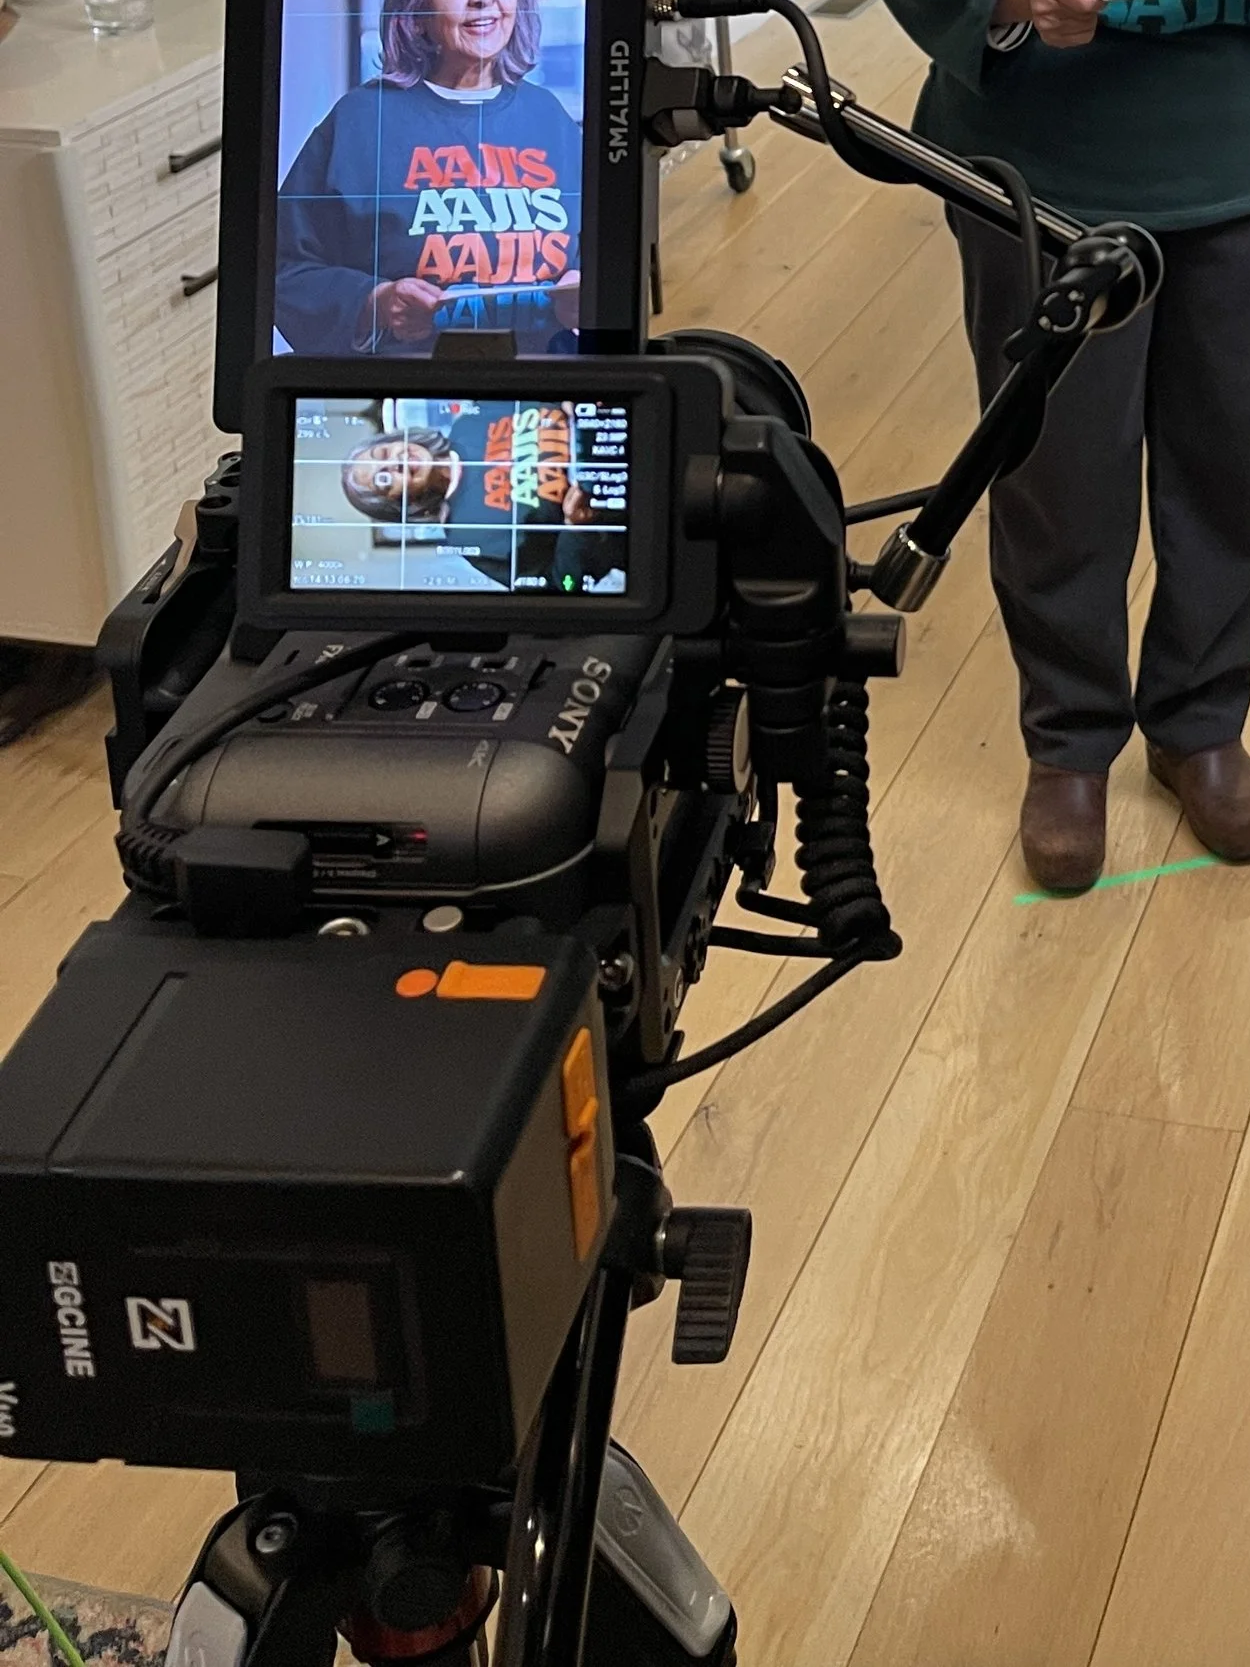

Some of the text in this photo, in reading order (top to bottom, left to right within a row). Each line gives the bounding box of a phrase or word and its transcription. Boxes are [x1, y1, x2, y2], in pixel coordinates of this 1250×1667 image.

[608, 40, 630, 164] SMALLHD
[403, 143, 557, 190] AAJI'S
[408, 187, 569, 236] AAJI'S
[416, 230, 571, 286] AAJI'S
[548, 656, 612, 754] SONY
